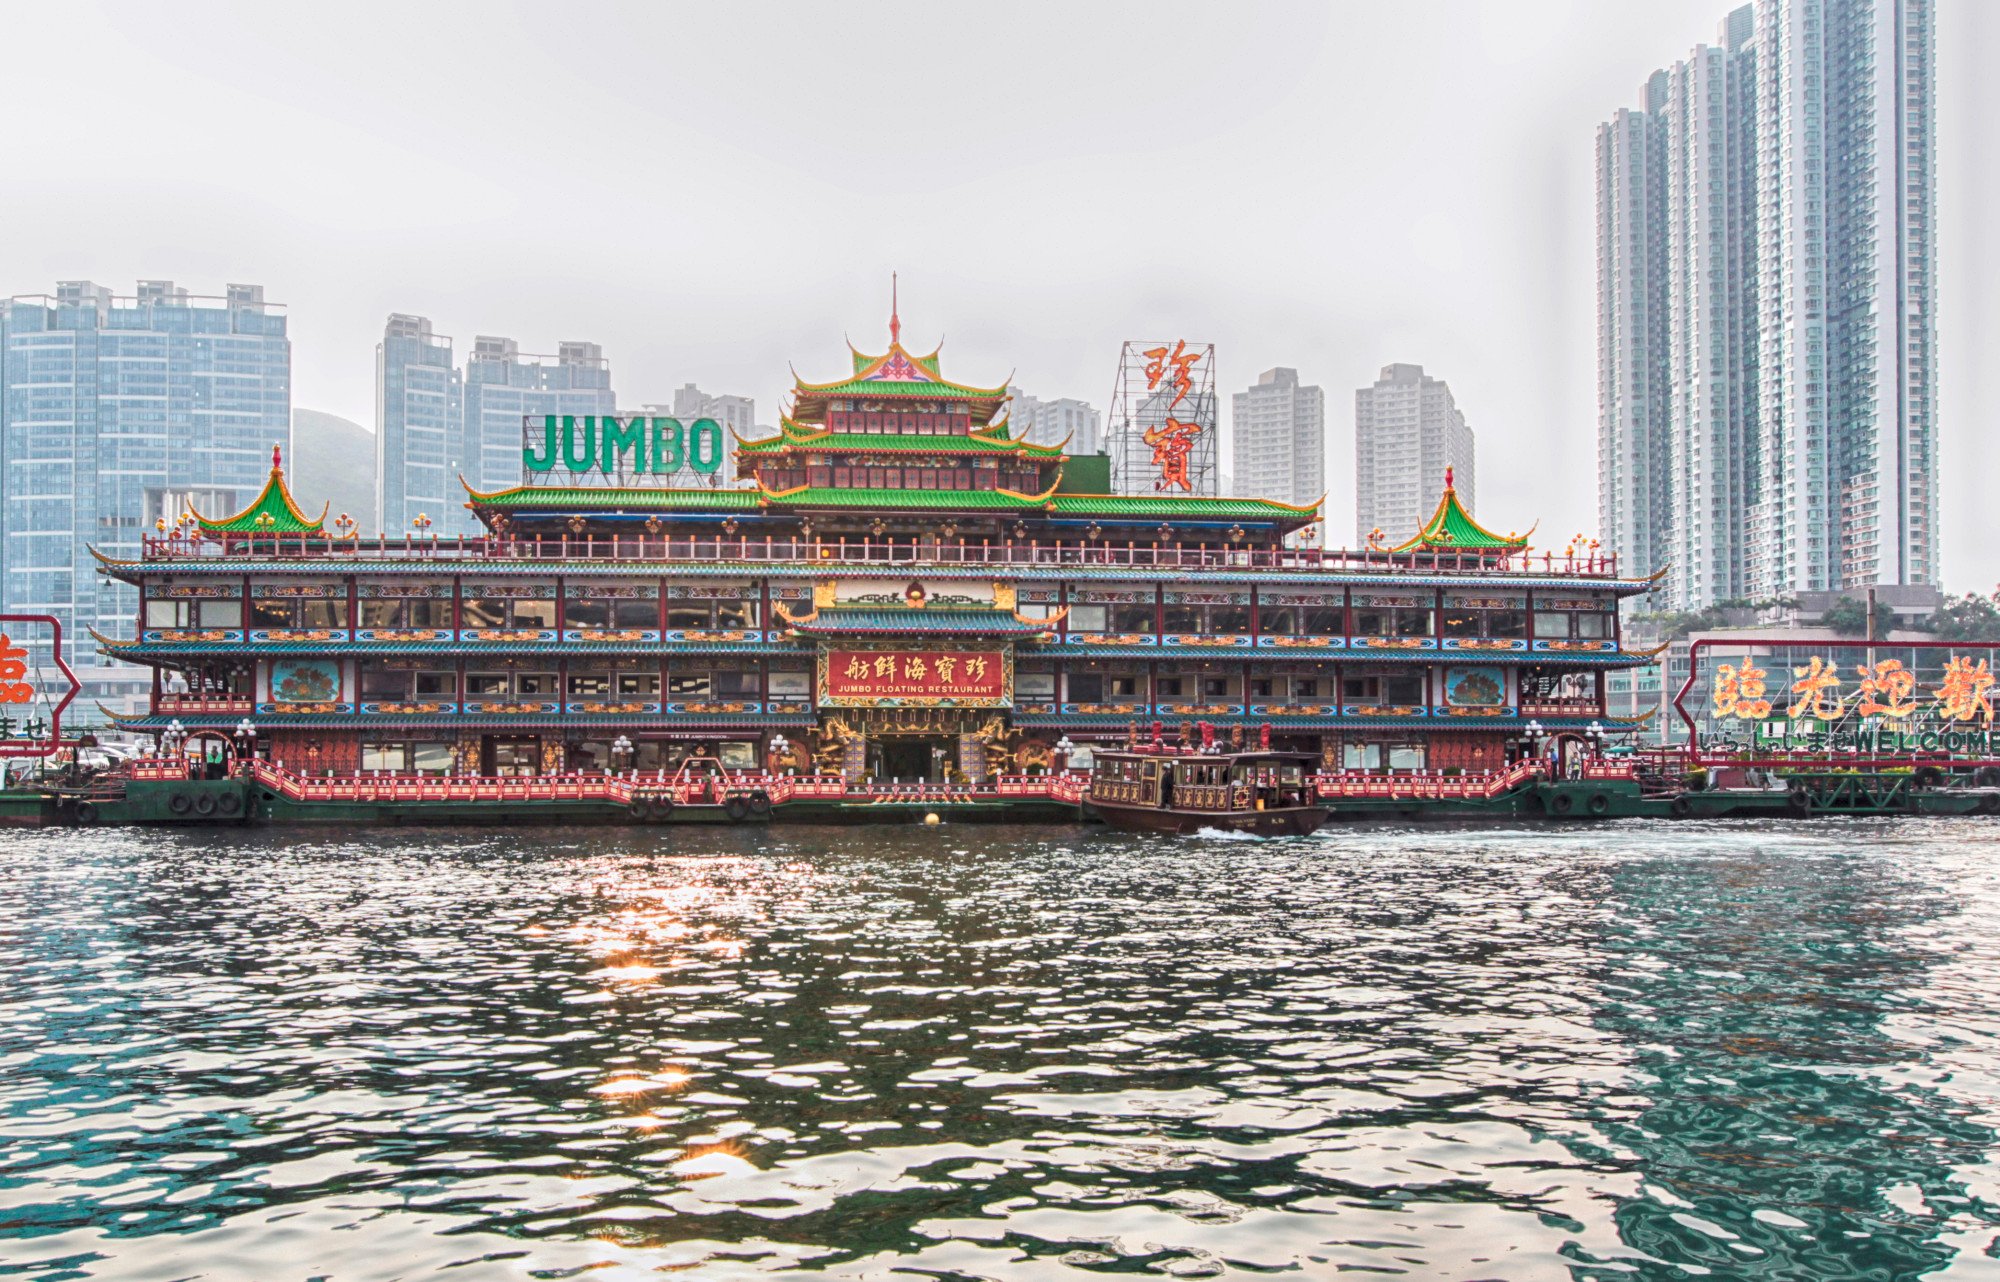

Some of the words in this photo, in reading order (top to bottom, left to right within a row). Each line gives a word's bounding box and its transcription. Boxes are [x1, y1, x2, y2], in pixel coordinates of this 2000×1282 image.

[523, 415, 723, 473] JUMBO
[838, 685, 871, 693] JUMBO
[876, 685, 924, 693] FLOATING
[928, 685, 993, 693] RESTAURANT
[1853, 731, 2000, 752] WELCOME
